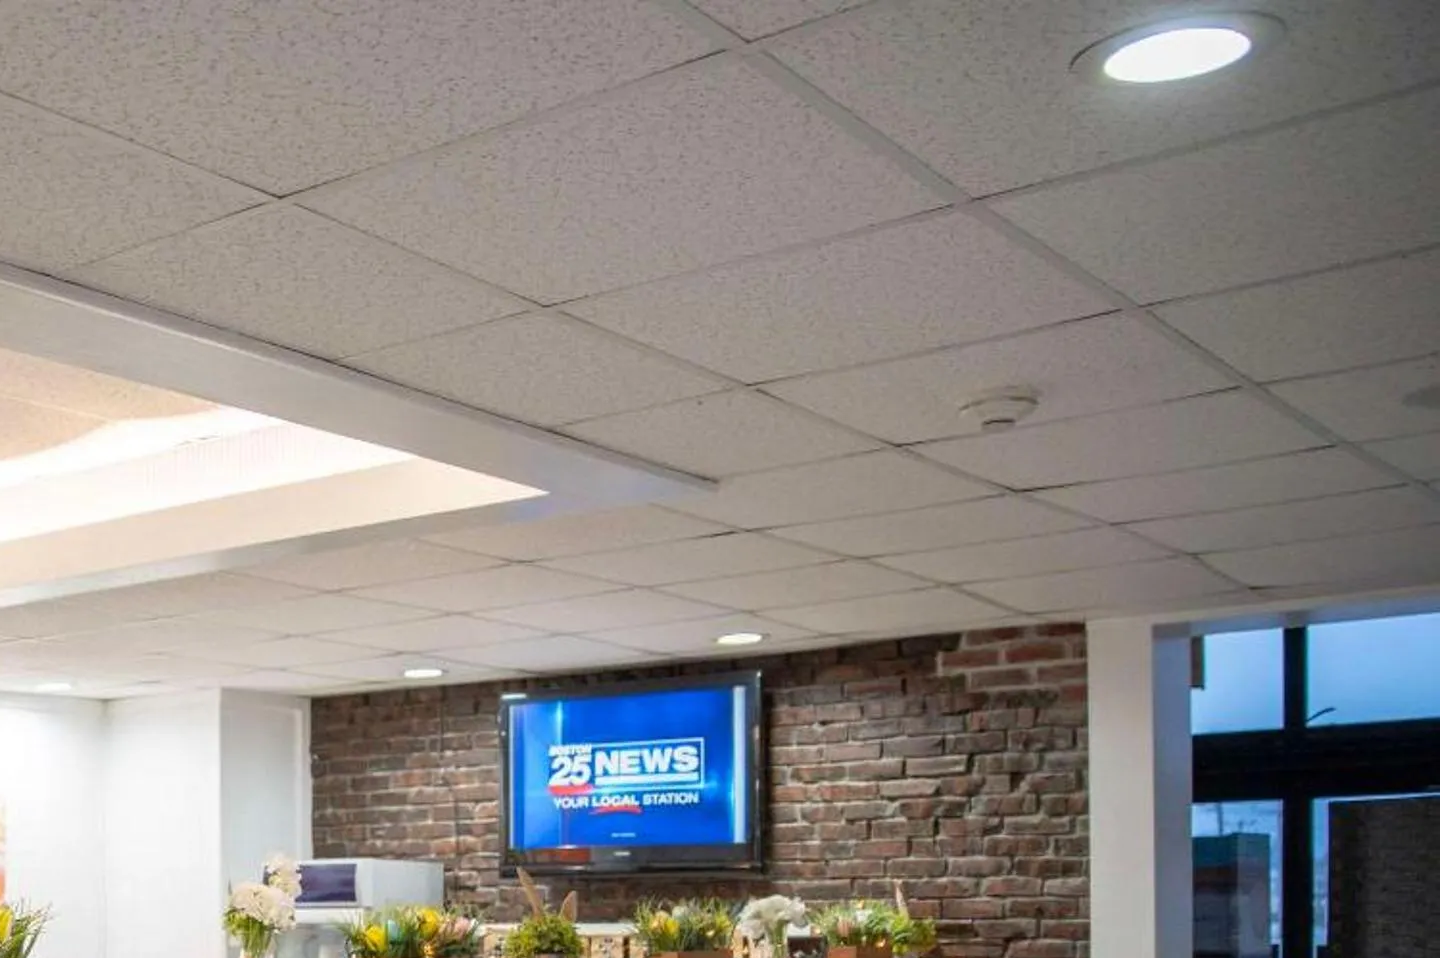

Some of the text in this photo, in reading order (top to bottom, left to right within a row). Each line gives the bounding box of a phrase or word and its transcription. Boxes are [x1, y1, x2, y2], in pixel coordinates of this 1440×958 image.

[549, 746, 699, 786] 25 NEWS
[553, 791, 699, 809] YOUR LOCAL STATION
